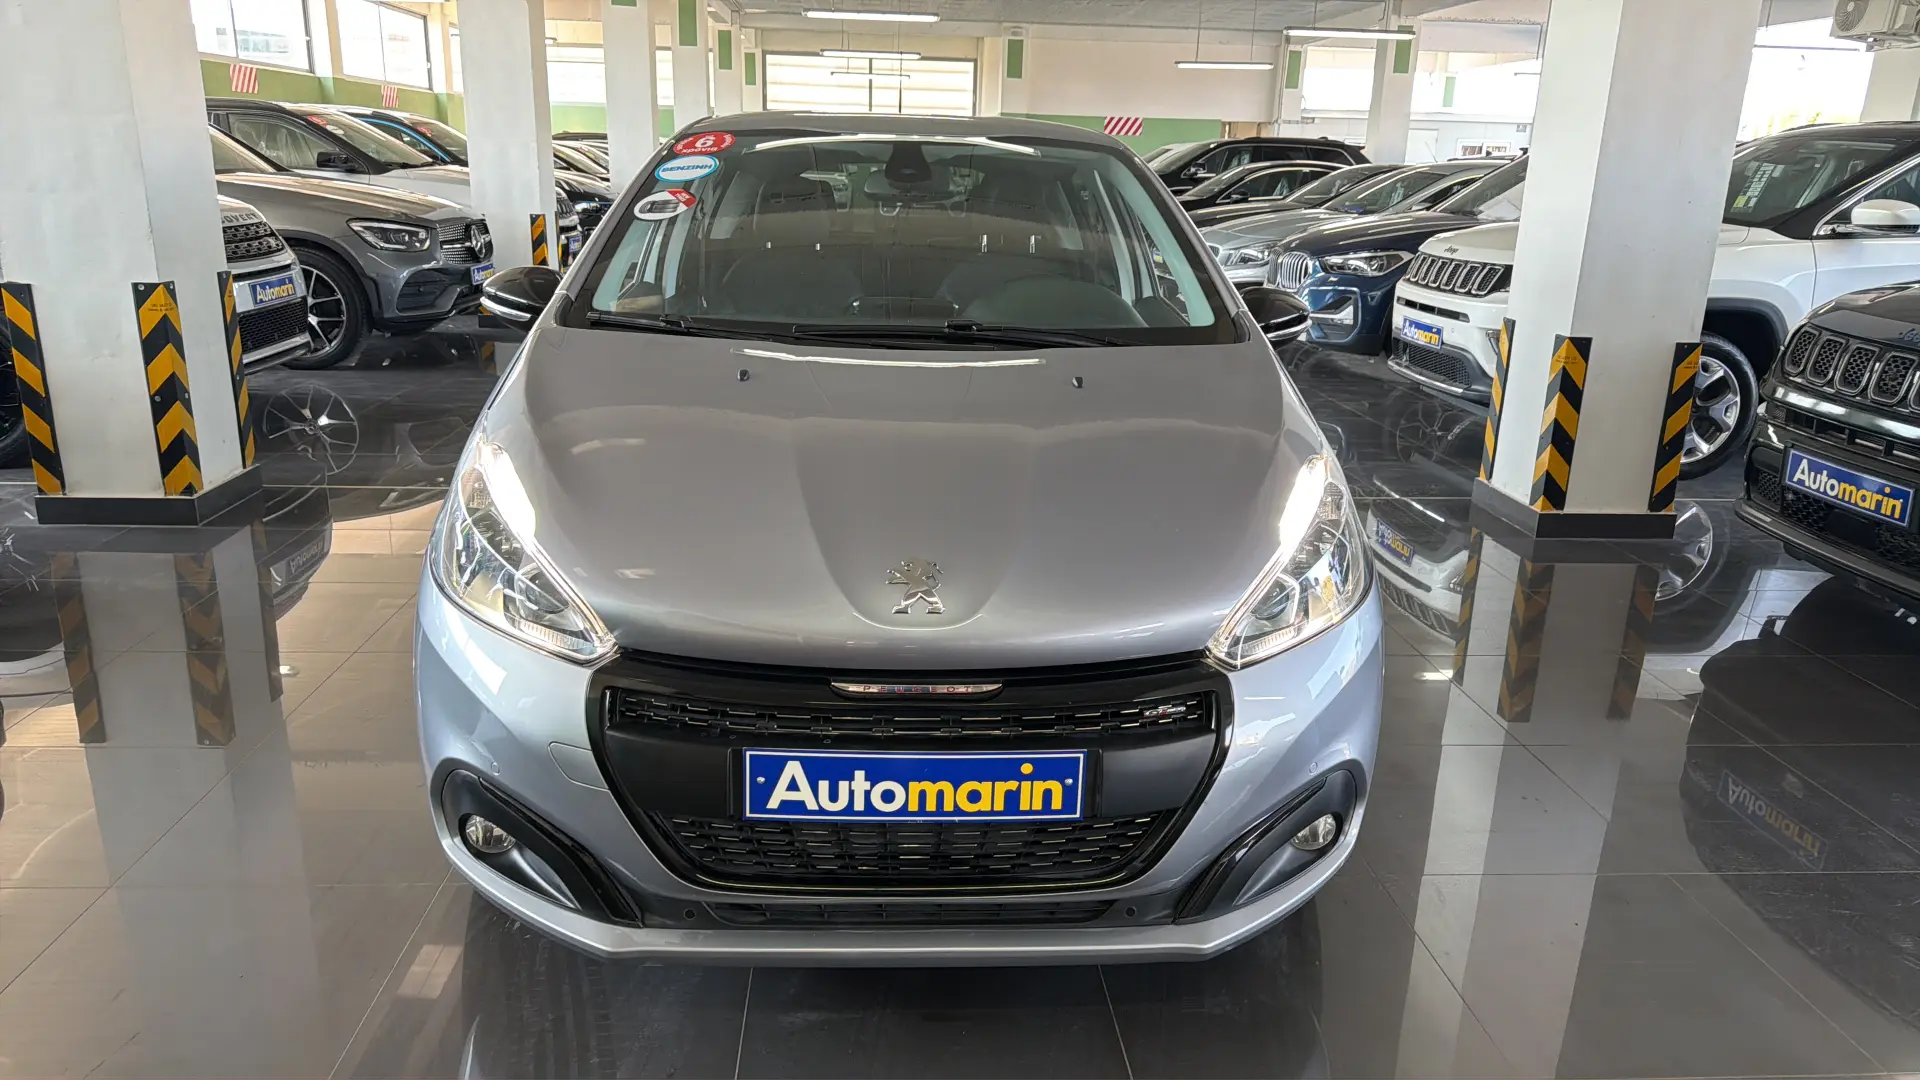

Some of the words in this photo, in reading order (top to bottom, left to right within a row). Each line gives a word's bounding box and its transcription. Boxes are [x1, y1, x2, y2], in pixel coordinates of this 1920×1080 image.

[694, 135, 716, 148] 6
[1792, 458, 1903, 519] Automarin
[862, 685, 971, 694] PEUGEOT
[766, 760, 1062, 812] Automarin
